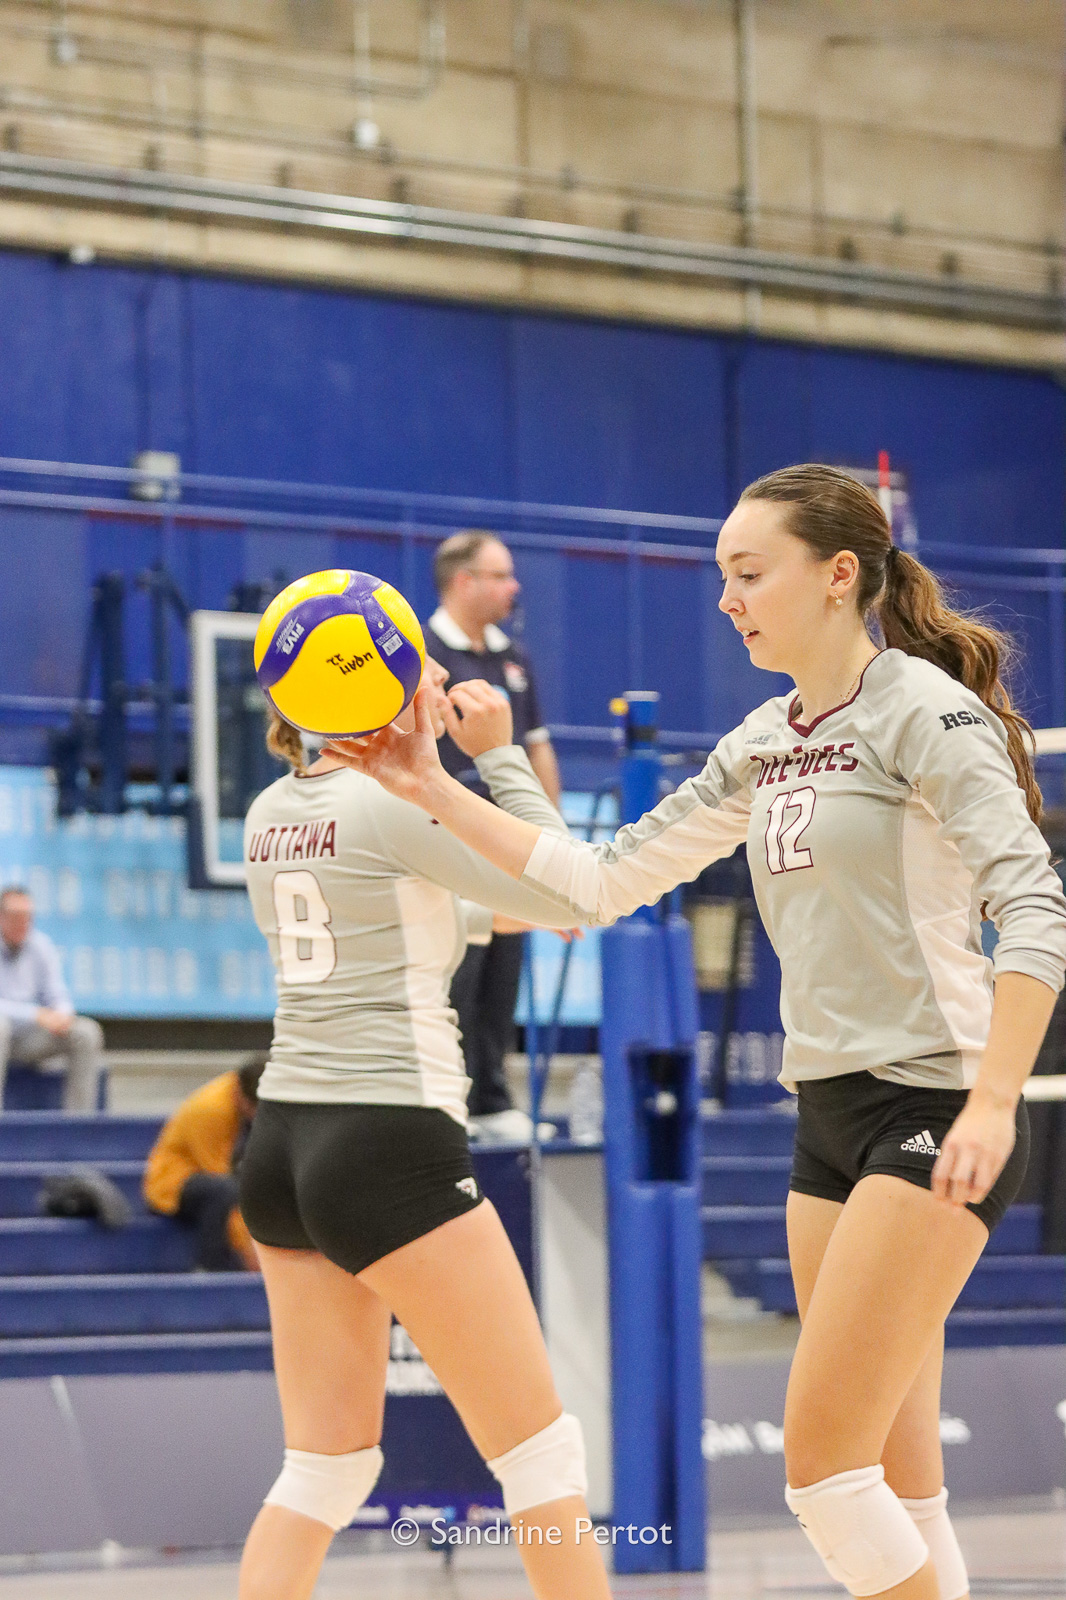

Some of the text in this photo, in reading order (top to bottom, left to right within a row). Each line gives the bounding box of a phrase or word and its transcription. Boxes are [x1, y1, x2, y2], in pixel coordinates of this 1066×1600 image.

[765, 786, 817, 875] 12
[272, 869, 337, 984] 8
[900, 1143, 942, 1156] adidas
